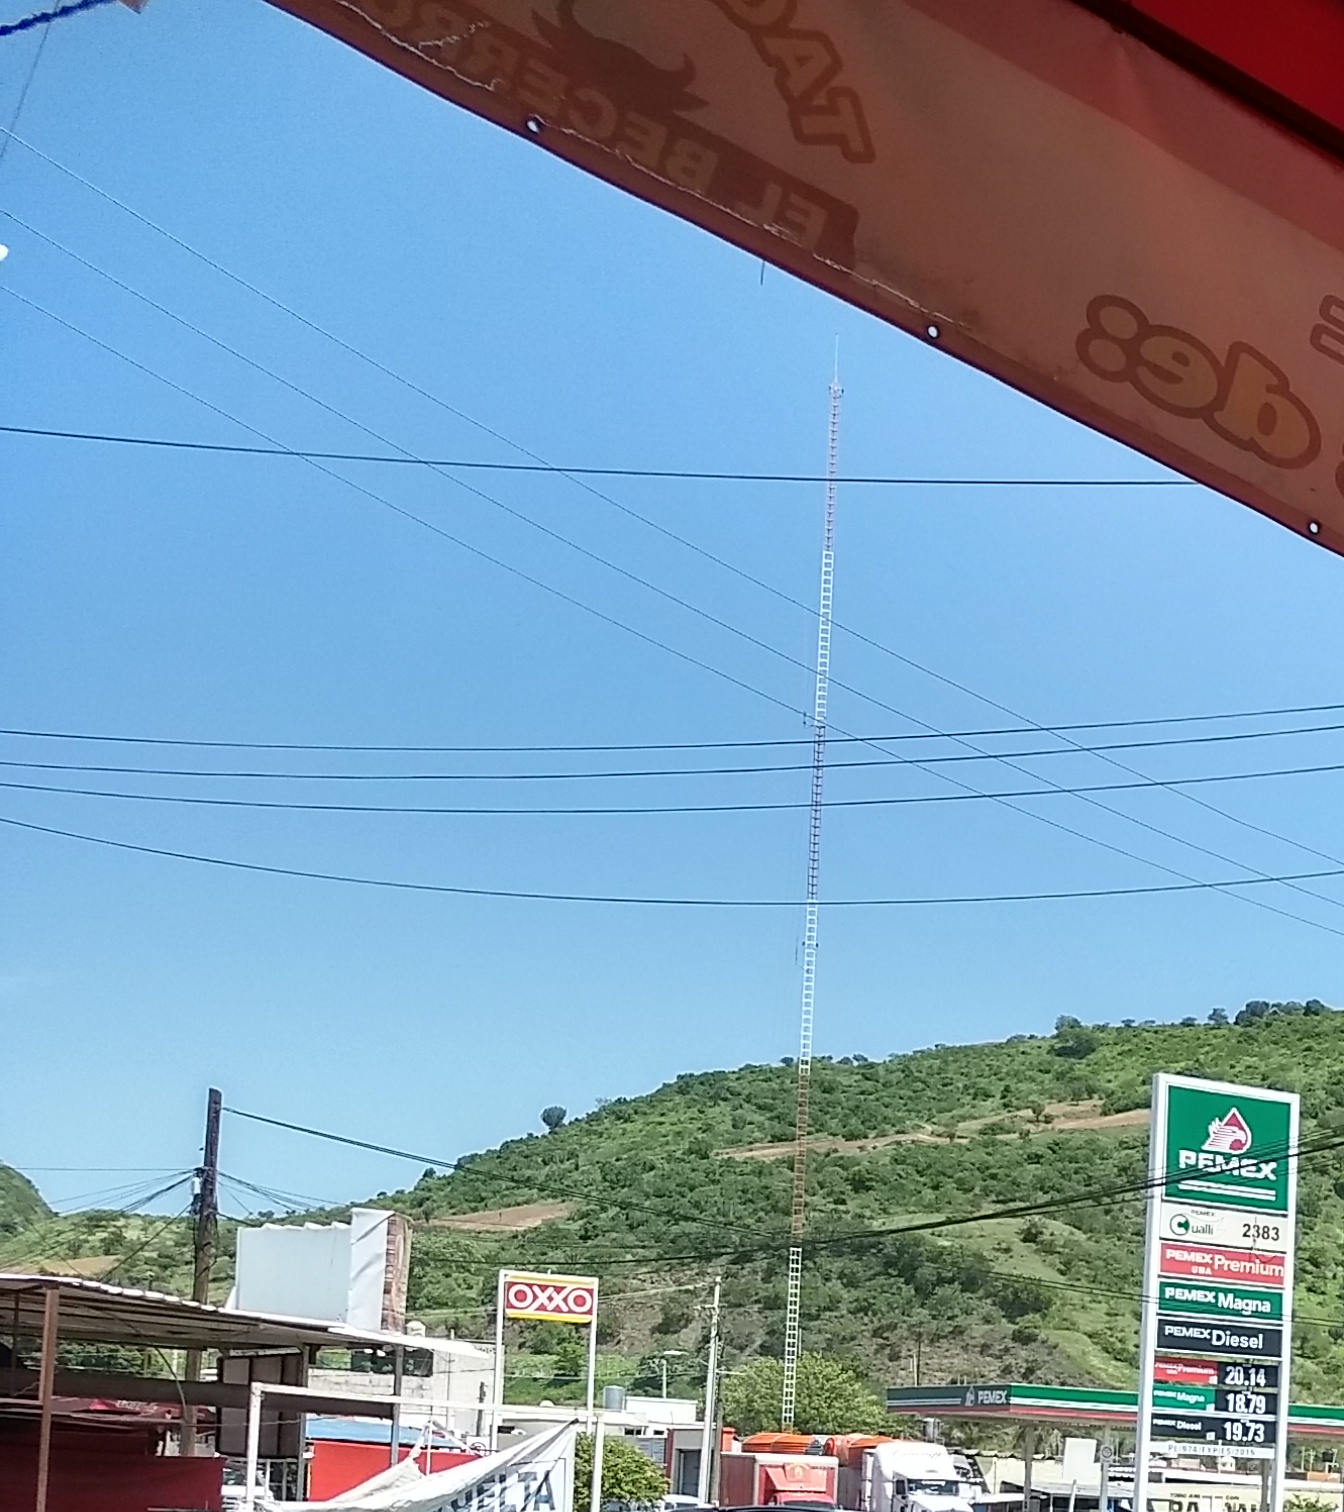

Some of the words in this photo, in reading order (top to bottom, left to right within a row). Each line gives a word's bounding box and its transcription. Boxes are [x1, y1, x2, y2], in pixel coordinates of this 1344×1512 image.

[1178, 1149, 1278, 1182] PEMEX
[1242, 1223, 1280, 1241] 2383
[1165, 1249, 1213, 1264] PEMEX
[1214, 1254, 1285, 1277] Premium
[507, 1284, 594, 1314] OXXO
[1164, 1287, 1216, 1302] PEMEX
[1217, 1292, 1271, 1315] Magna
[1164, 1325, 1211, 1339] PEMEX
[1211, 1330, 1264, 1350] Diesel
[1225, 1365, 1267, 1387] 20.14
[977, 1389, 1008, 1405] PEMEX
[1226, 1393, 1266, 1414] 18.79
[1224, 1421, 1265, 1442] 19.73
